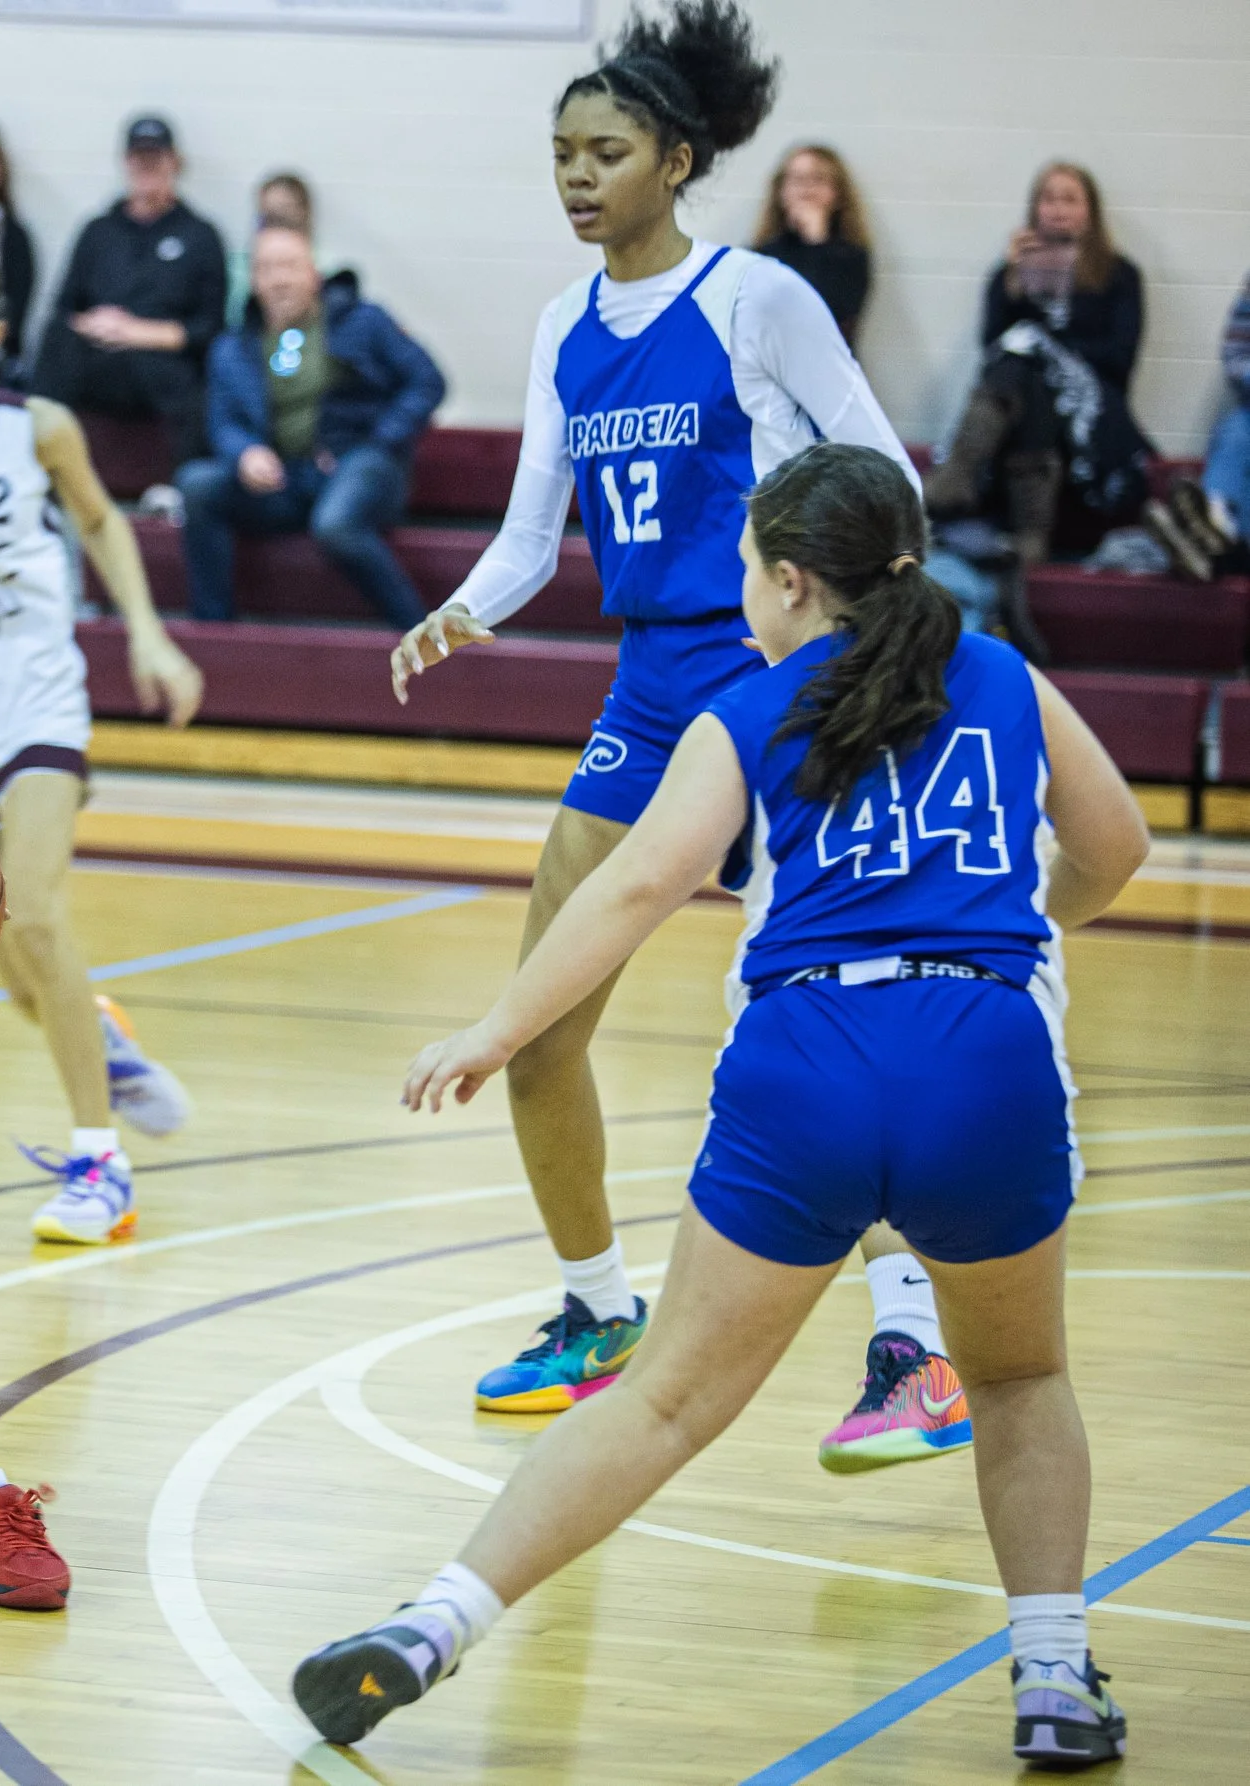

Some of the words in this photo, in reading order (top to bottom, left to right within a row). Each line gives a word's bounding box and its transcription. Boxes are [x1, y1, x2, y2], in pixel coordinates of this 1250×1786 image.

[569, 402, 699, 460] PAIDEIA
[601, 460, 662, 544] 12
[815, 727, 1011, 879] 44
